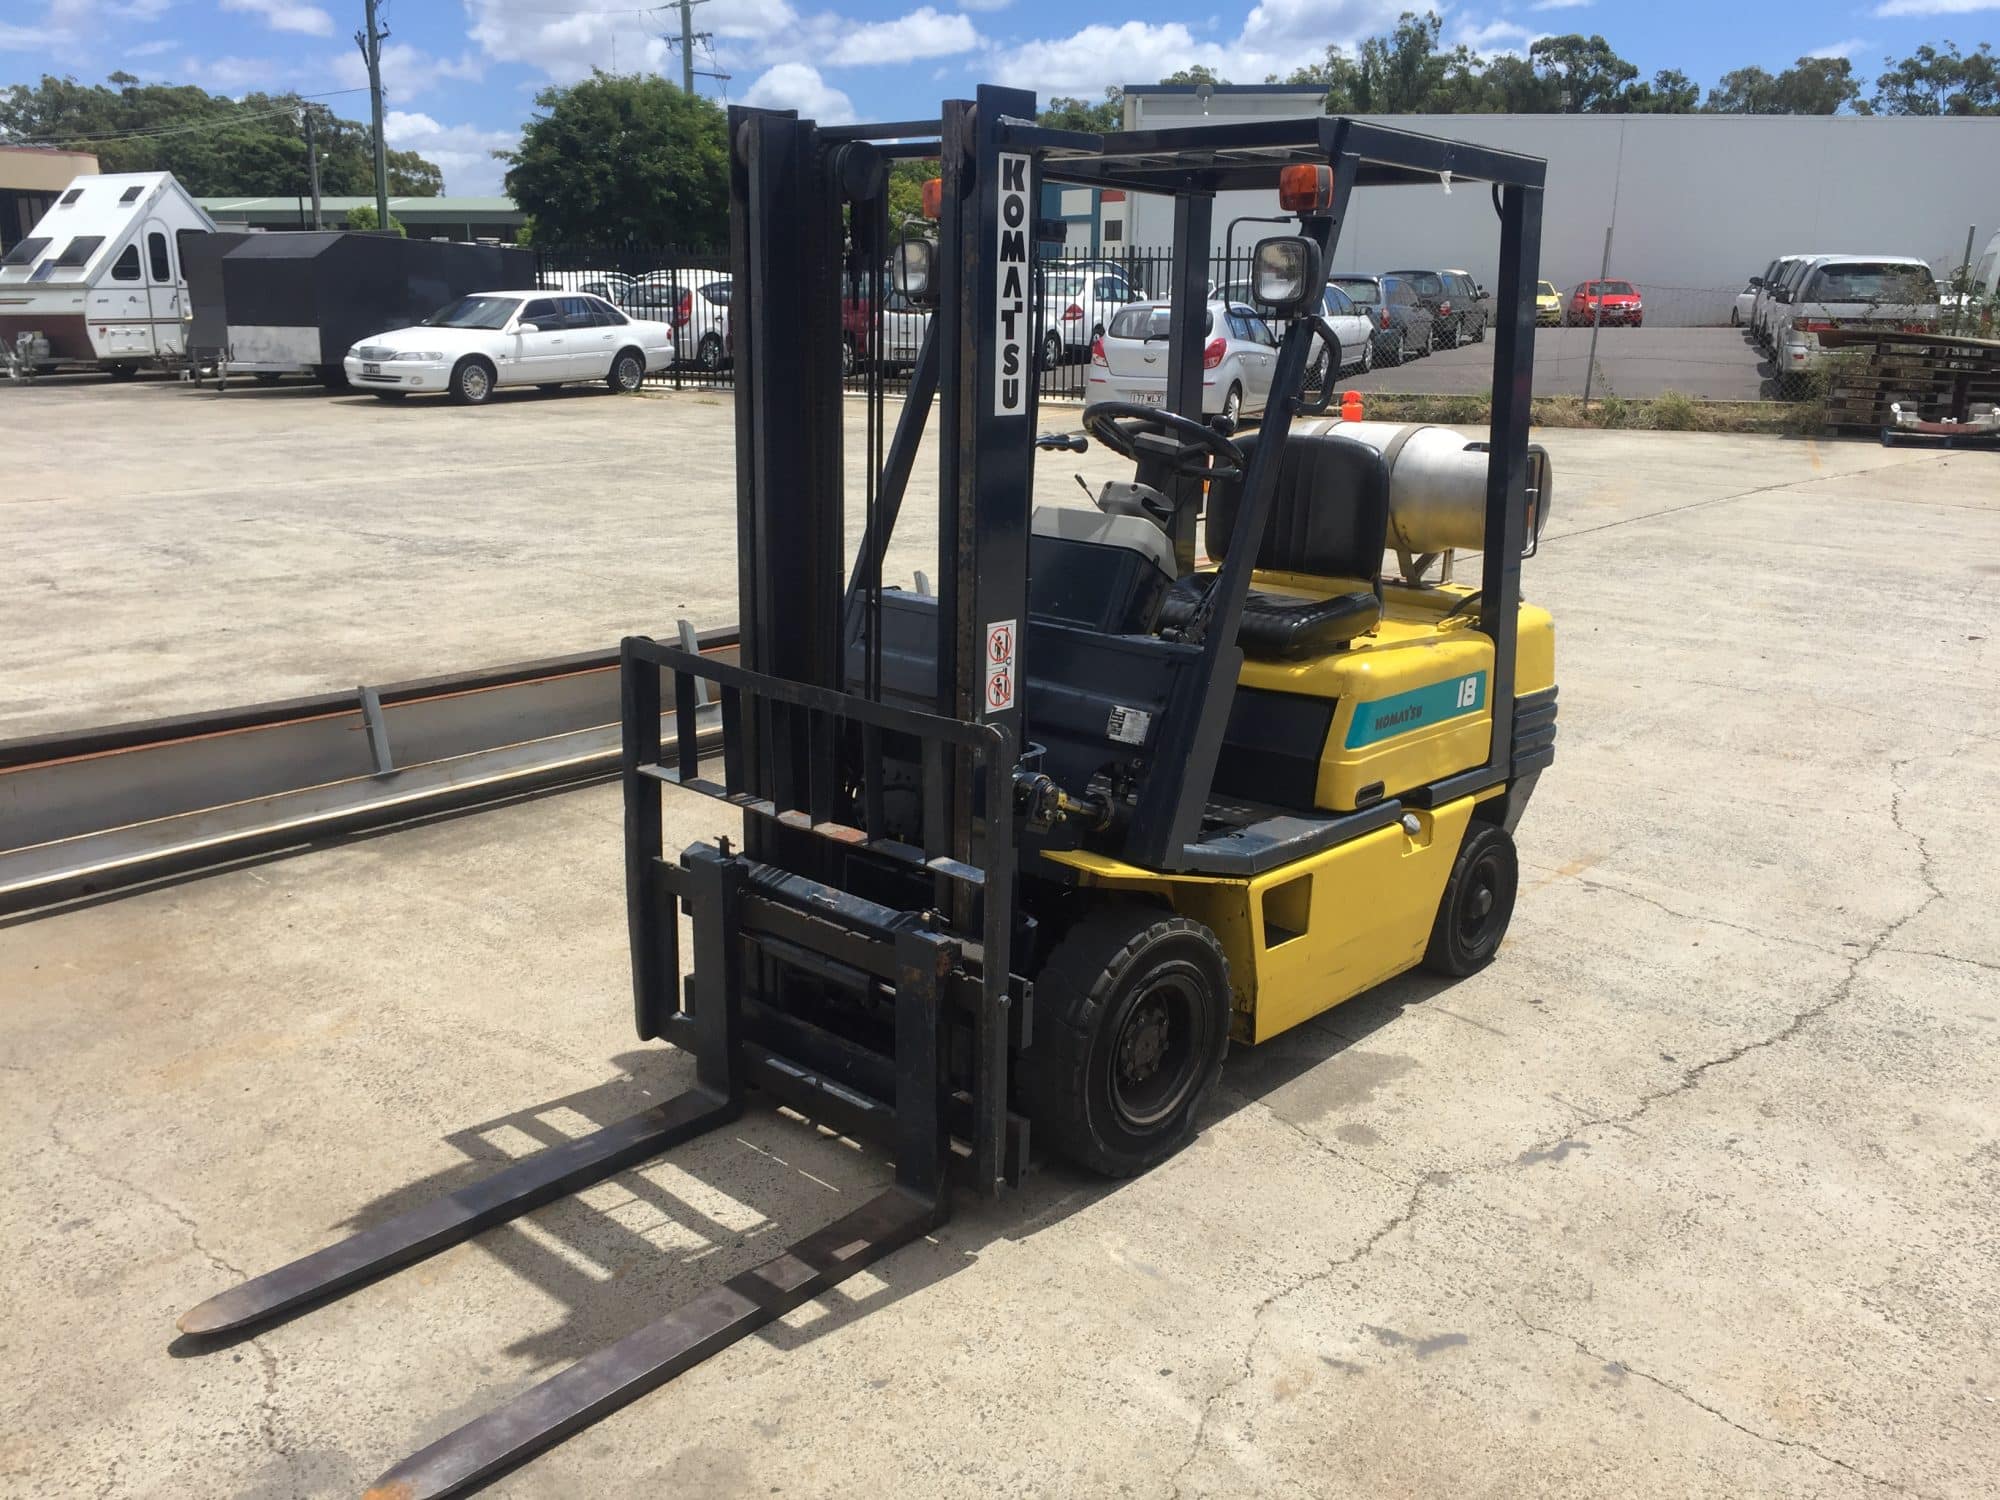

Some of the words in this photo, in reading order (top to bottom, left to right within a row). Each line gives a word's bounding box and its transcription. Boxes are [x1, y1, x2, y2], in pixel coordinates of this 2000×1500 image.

[1000, 158, 1026, 409] KOMATSU
[1456, 676, 1477, 708] 18
[1375, 704, 1423, 730] KOMATSU
